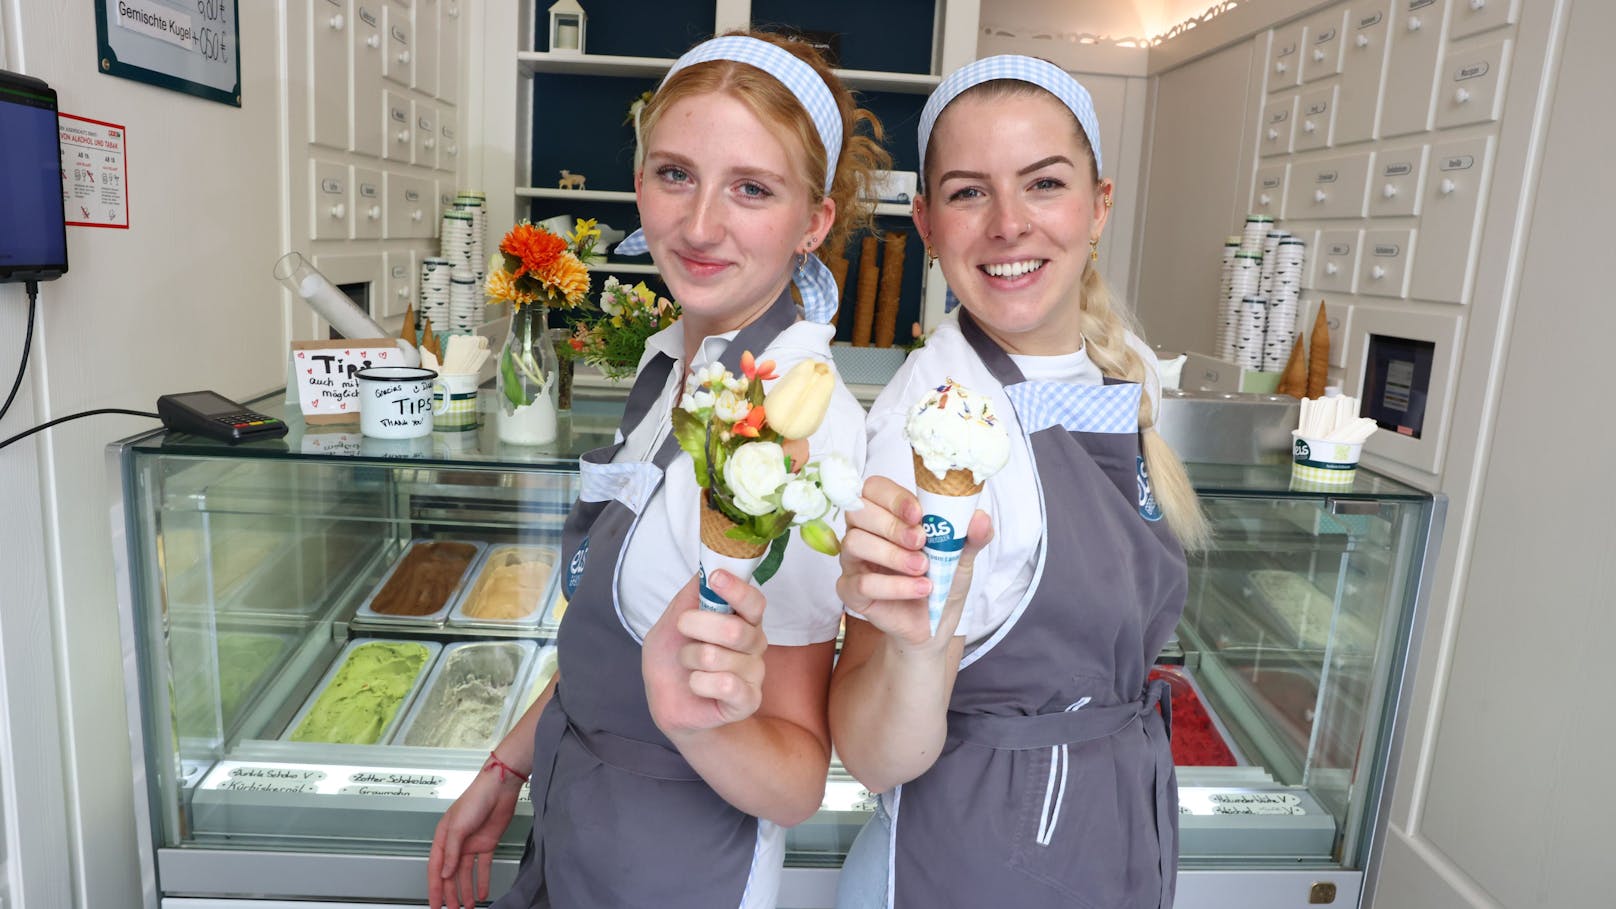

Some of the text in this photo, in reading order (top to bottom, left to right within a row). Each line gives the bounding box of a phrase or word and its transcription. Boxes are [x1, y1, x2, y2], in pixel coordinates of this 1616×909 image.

[119, 2, 167, 31] Gemischte
[169, 19, 191, 41] Kugel
[72, 135, 93, 145] ALKOHOL
[95, 139, 104, 147] UND
[105, 141, 118, 149] TABAK
[309, 378, 333, 387] auch
[375, 385, 402, 398] Gracias
[923, 517, 951, 537] eis
[386, 775, 439, 786] Schokolade
